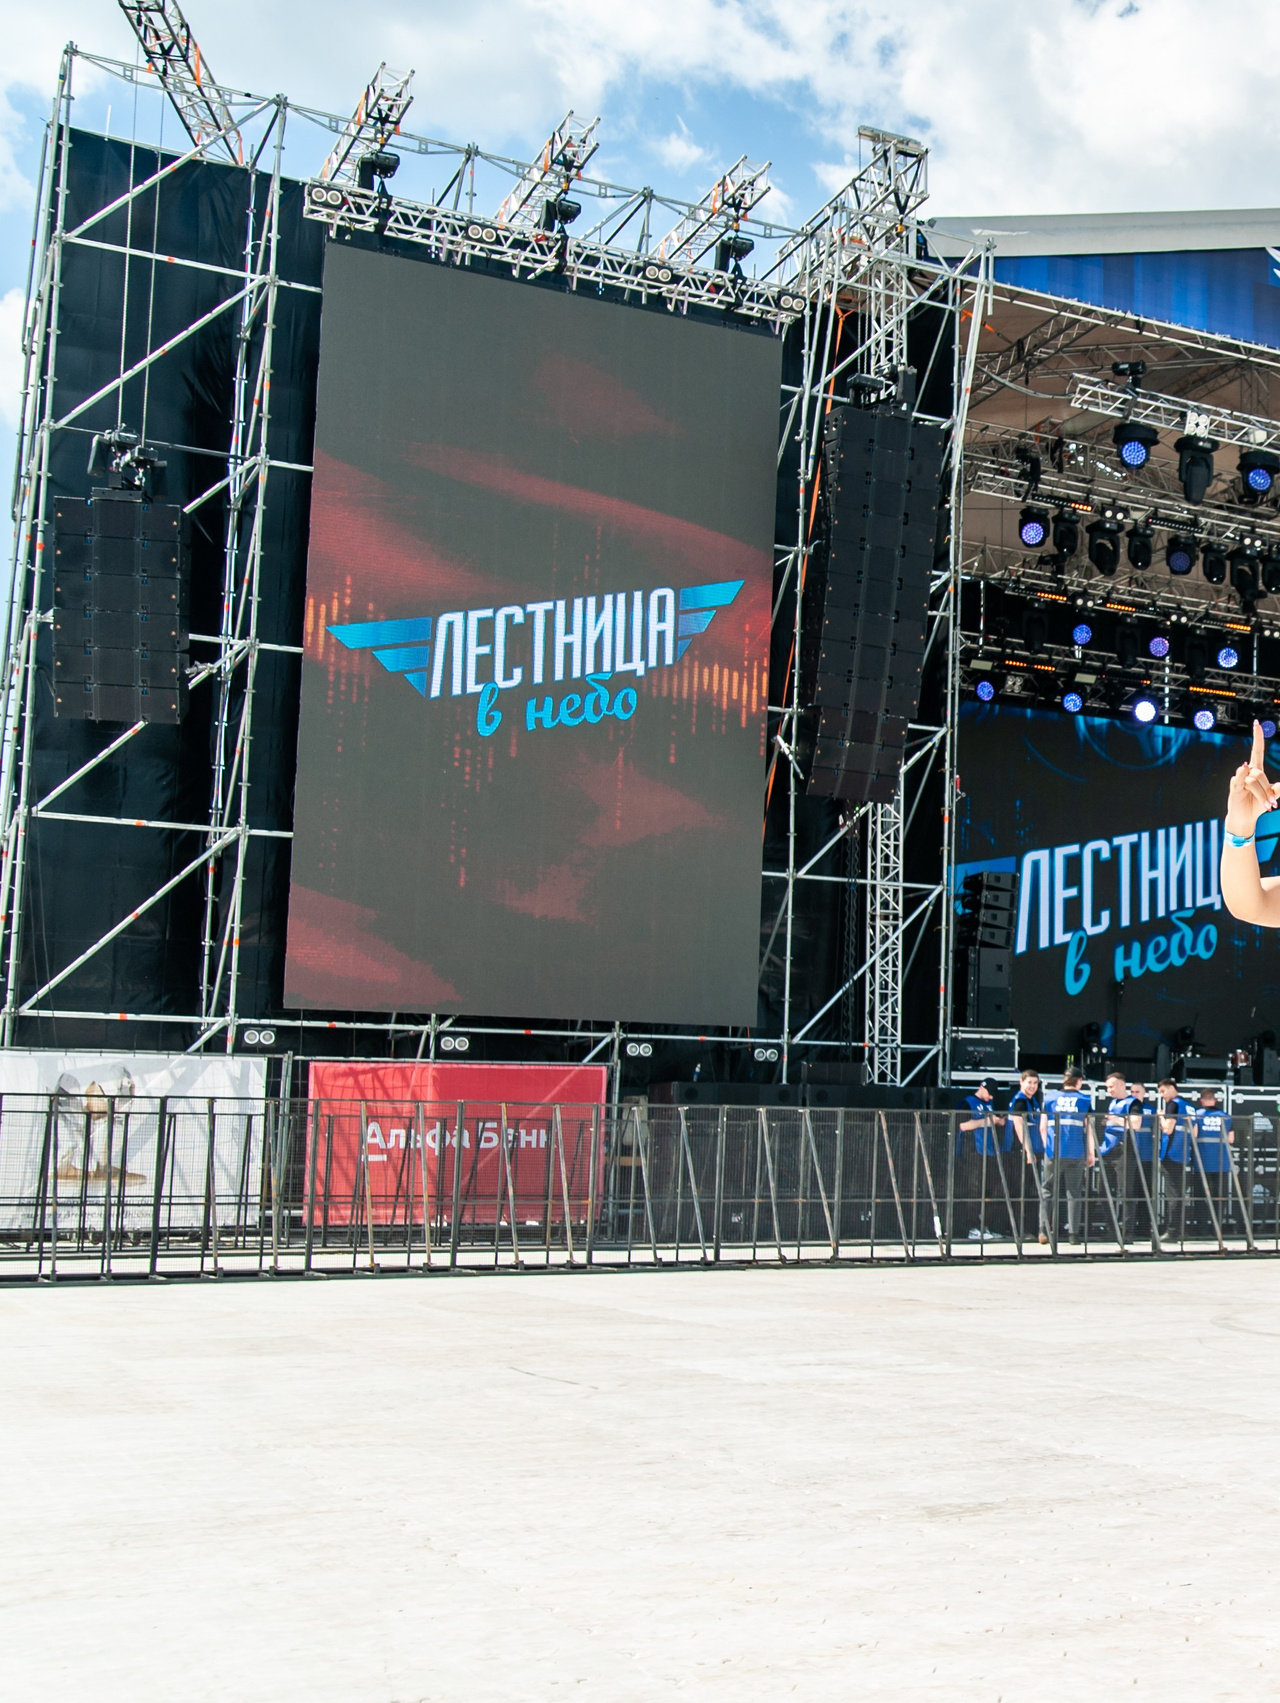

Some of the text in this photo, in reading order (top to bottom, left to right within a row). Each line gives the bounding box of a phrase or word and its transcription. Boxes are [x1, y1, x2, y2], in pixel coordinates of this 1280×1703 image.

[430, 587, 677, 699] ЛЕСТНИЦА
[477, 673, 638, 737] в небо
[1015, 818, 1223, 955] ЛЕСТНИЦ
[1064, 909, 1218, 996] в небо
[362, 1122, 470, 1156] Альфа
